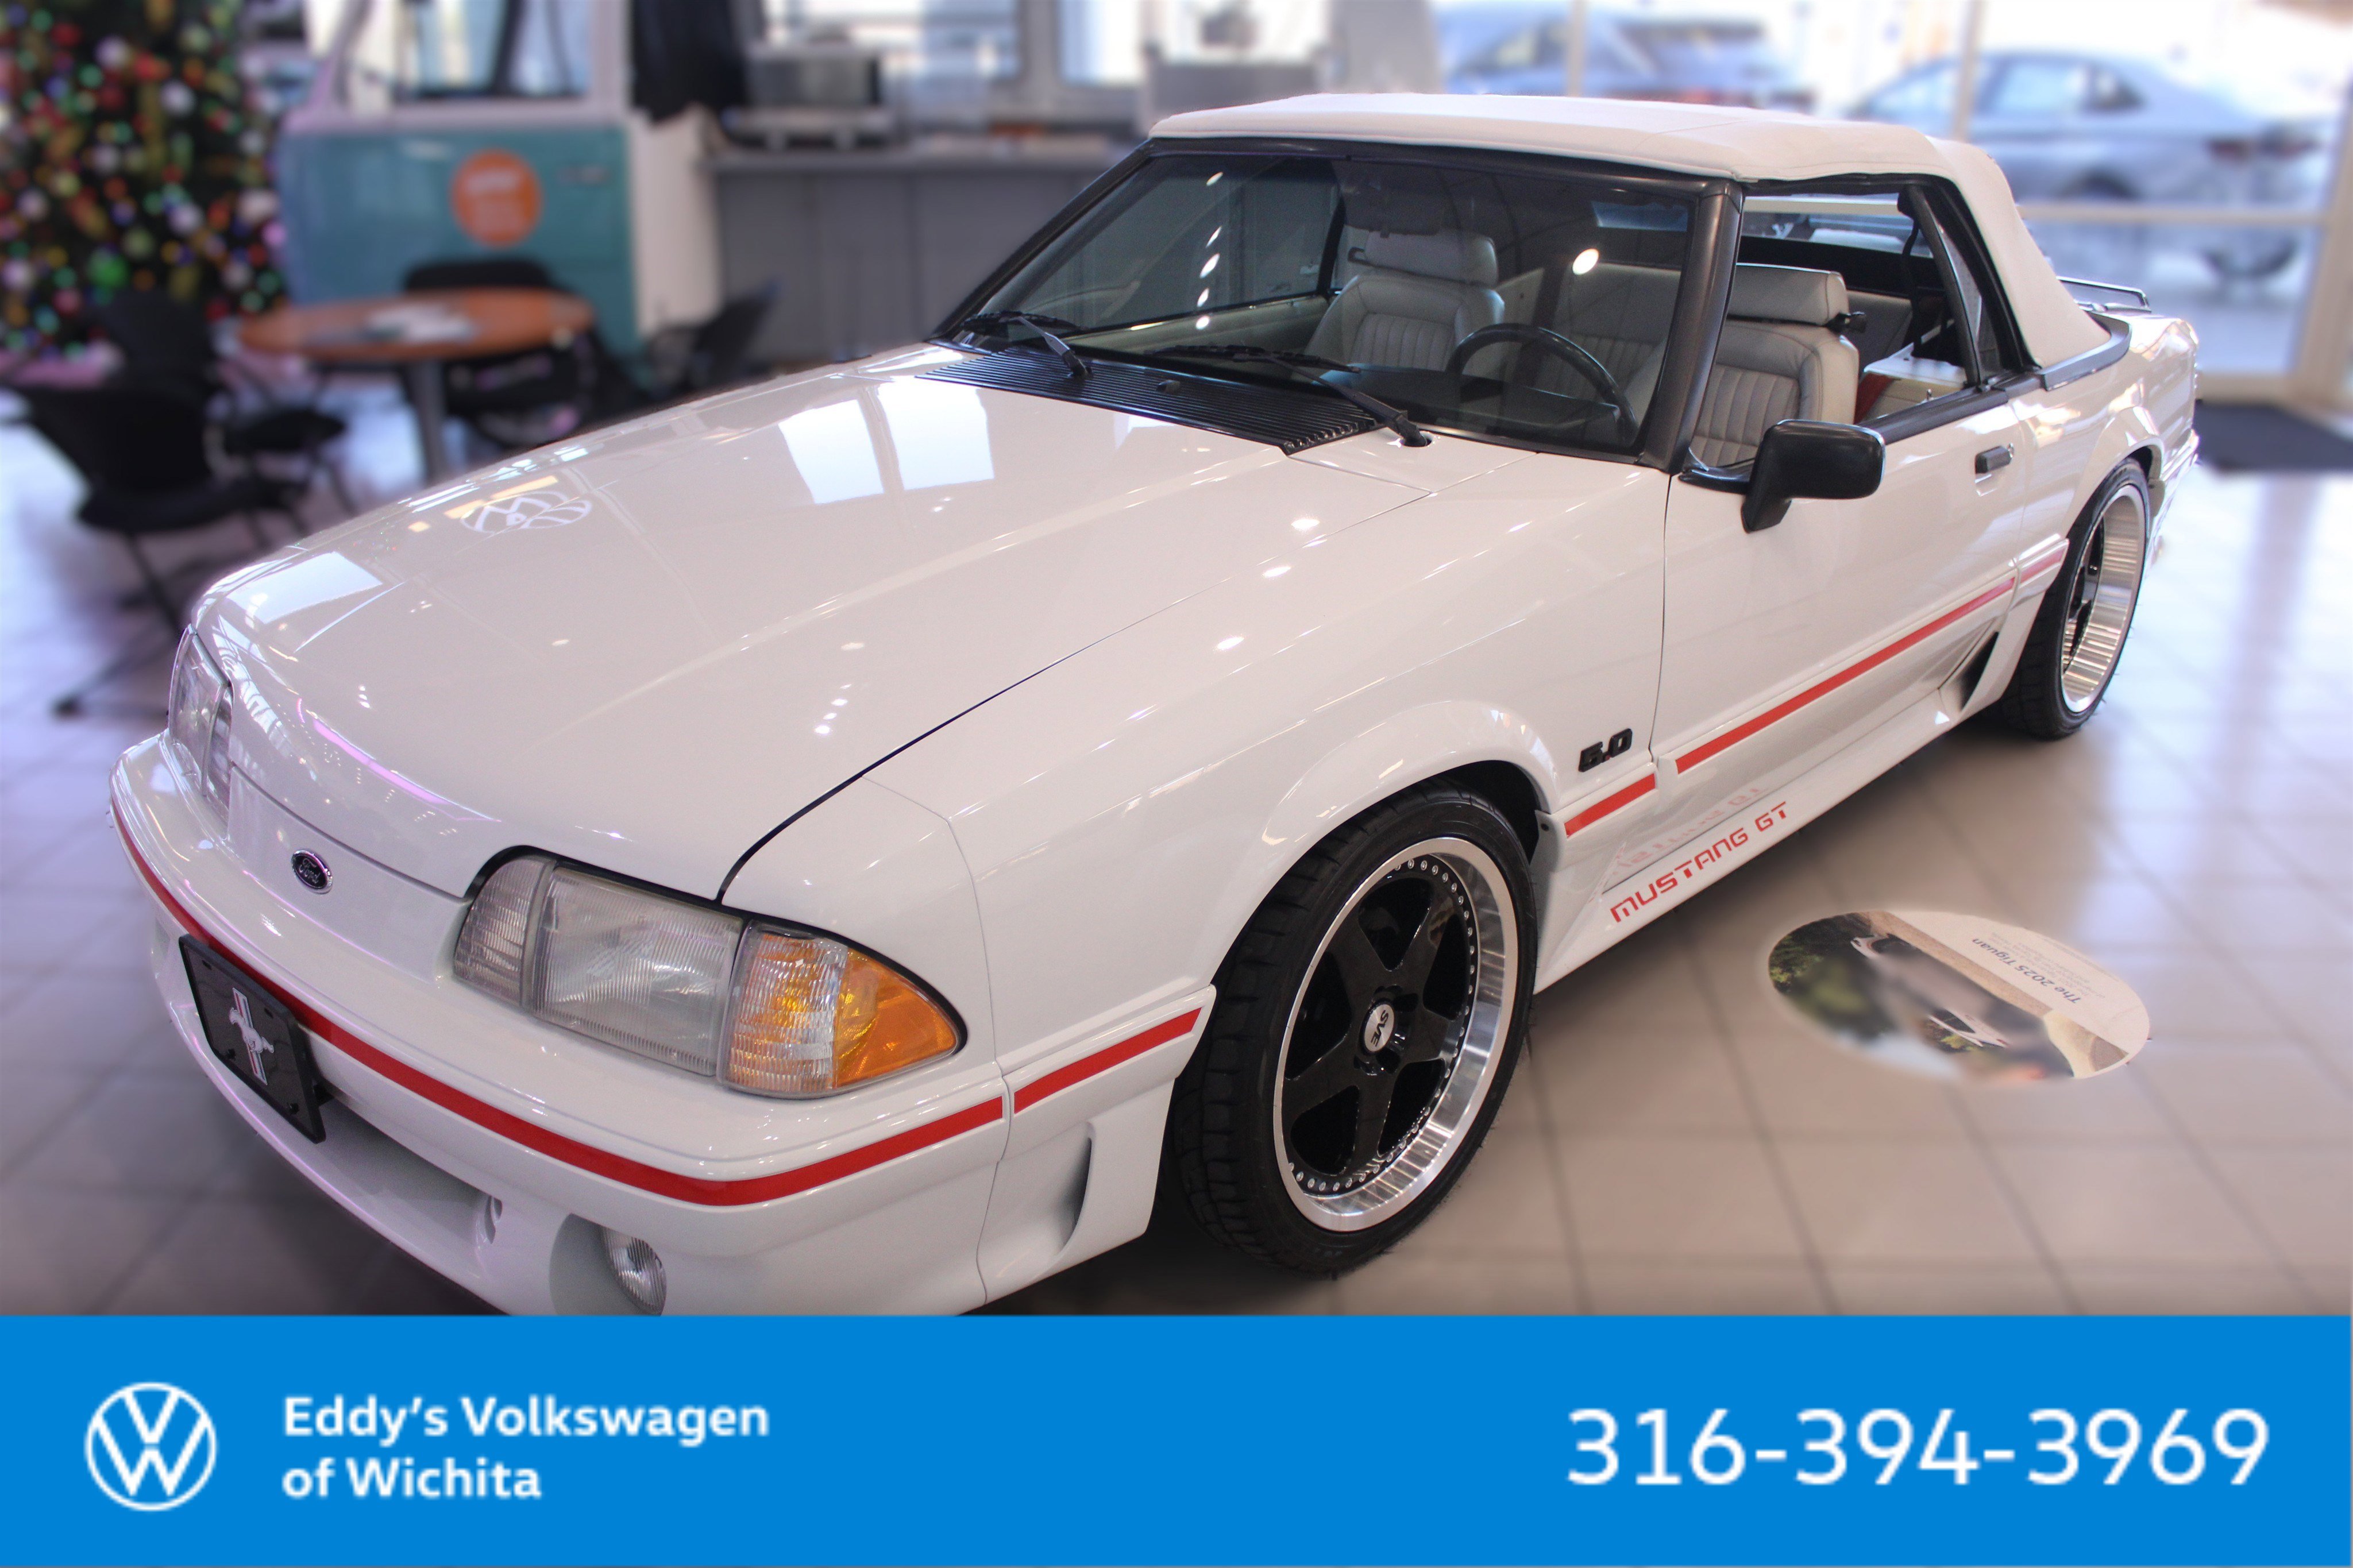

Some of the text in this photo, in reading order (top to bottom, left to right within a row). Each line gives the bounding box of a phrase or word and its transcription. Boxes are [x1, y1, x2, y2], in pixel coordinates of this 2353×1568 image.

[1578, 728, 1633, 772] 5.0
[1610, 828, 1749, 922] MUSTANG
[1756, 802, 1787, 832] GT
[1971, 937, 2016, 966] Tiguan
[2015, 964, 2055, 987] 2025
[2054, 987, 2082, 1003] The
[1371, 1010, 1389, 1047] SVE
